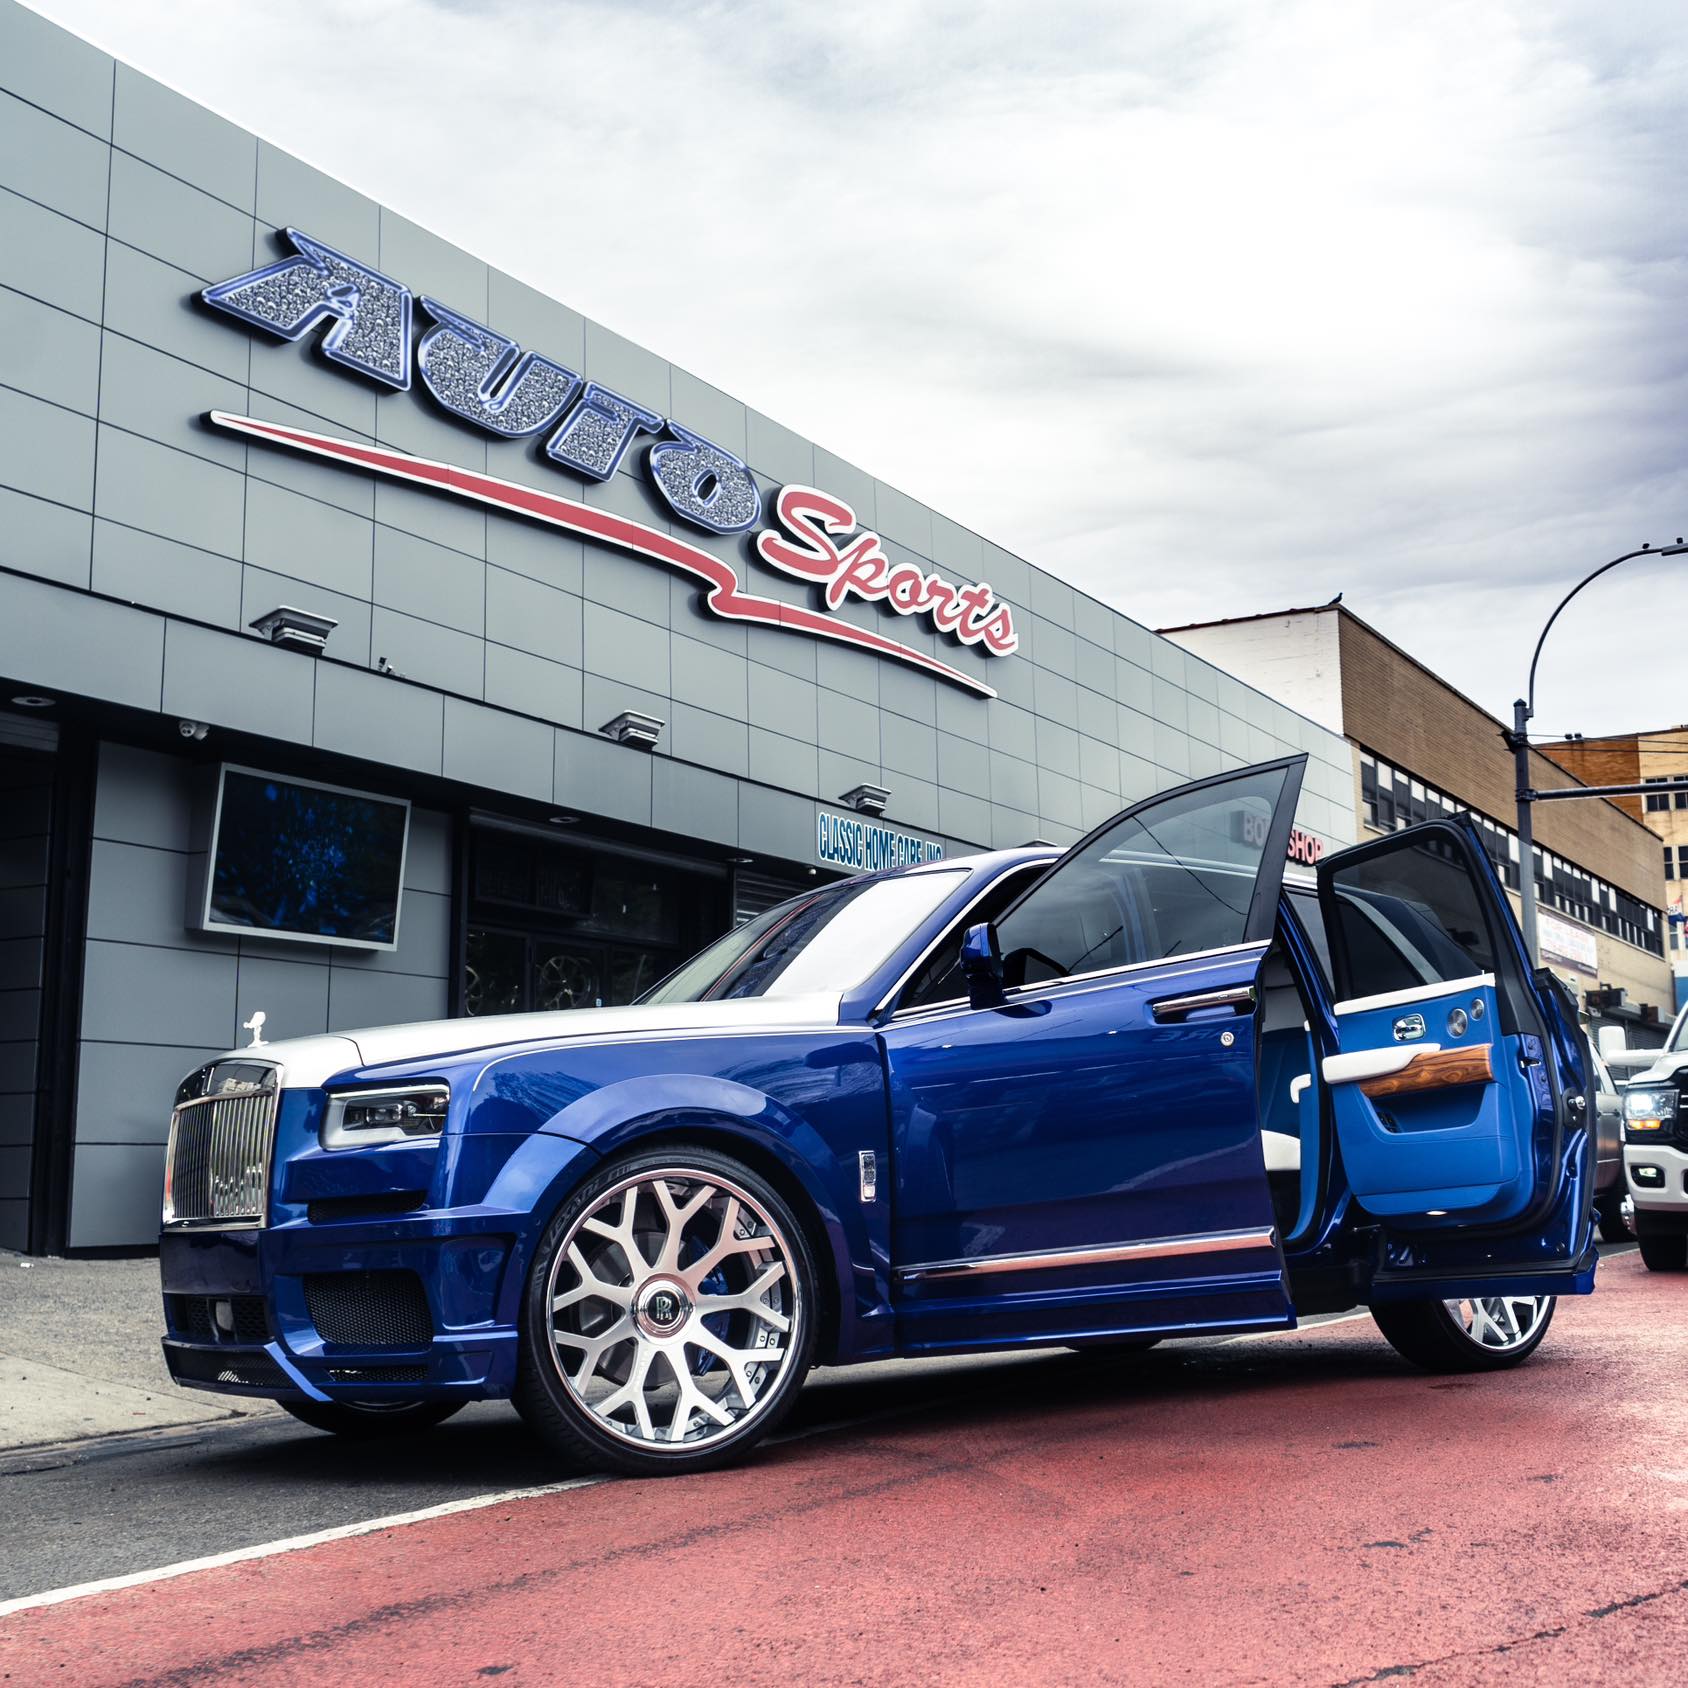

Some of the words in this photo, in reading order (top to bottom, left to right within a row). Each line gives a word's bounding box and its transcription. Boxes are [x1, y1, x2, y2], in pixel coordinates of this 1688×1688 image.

[202, 226, 762, 535] AUTO
[756, 484, 1019, 657] Sports
[819, 812, 863, 869] CLASSIC
[864, 825, 895, 871] HOME
[1243, 811, 1270, 847] BO
[1287, 829, 1323, 864] SHOP
